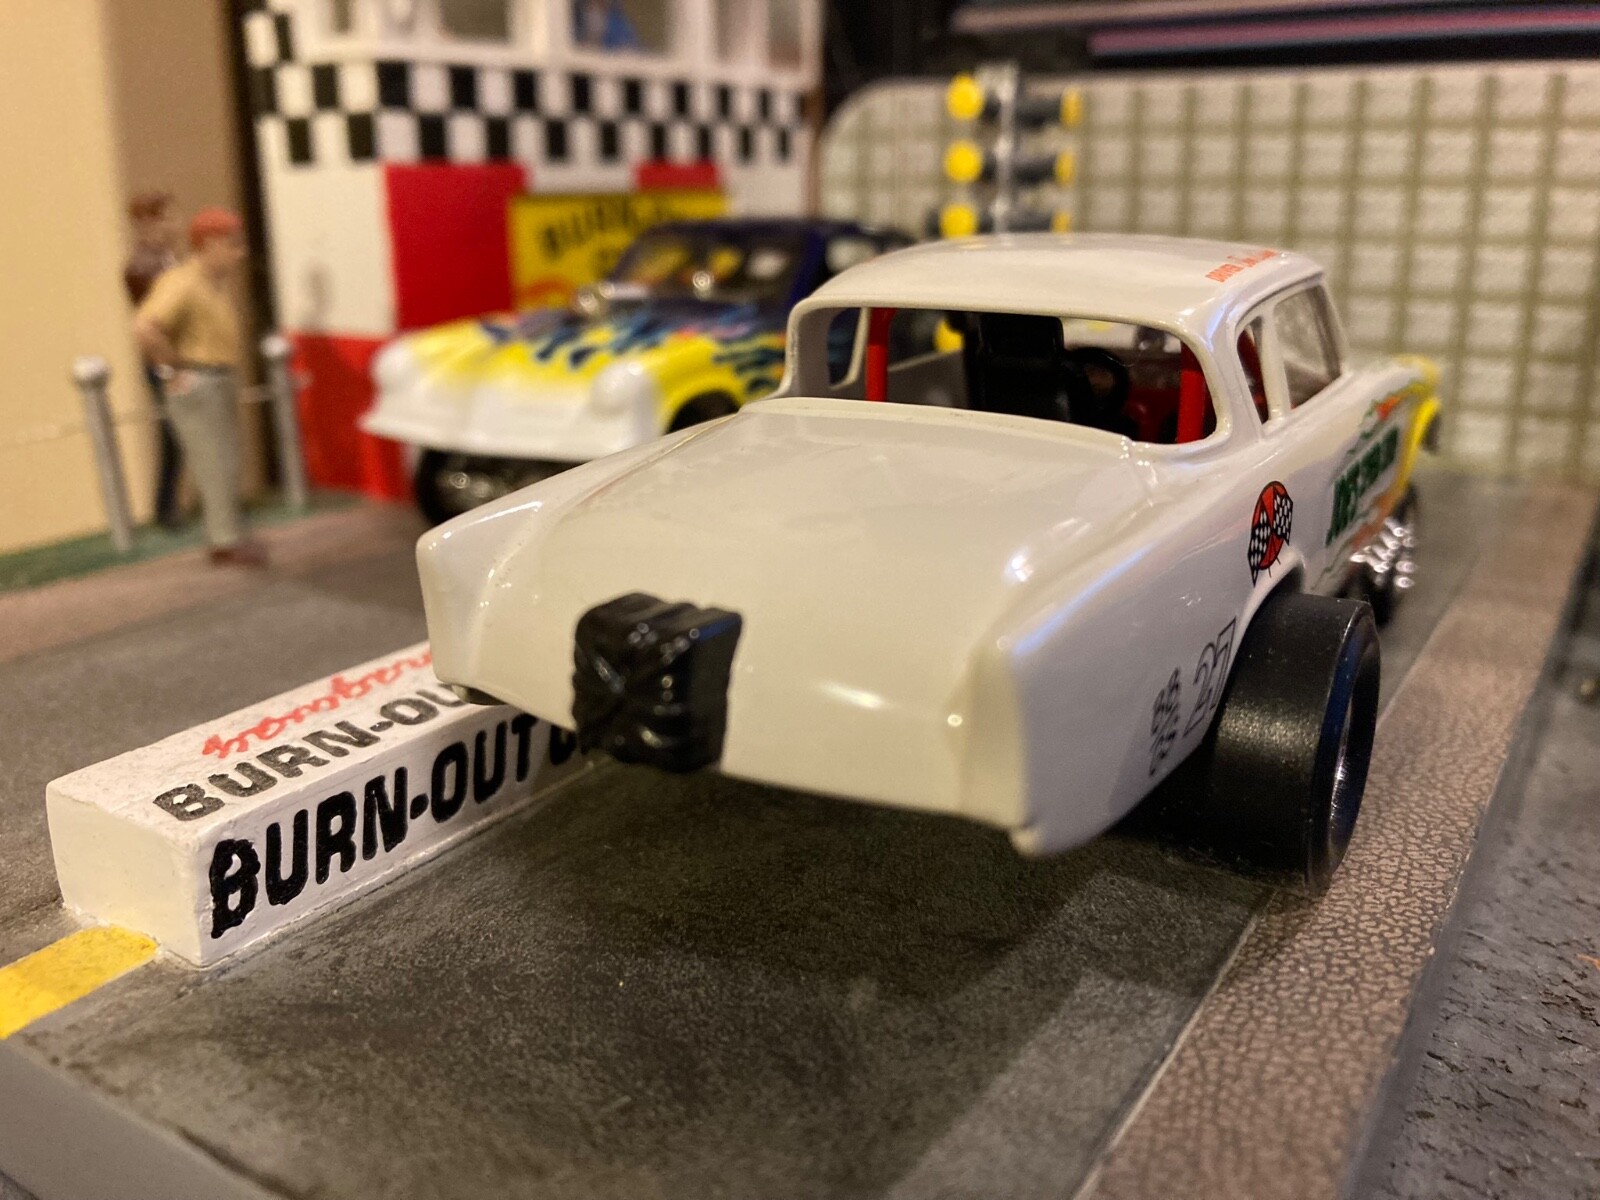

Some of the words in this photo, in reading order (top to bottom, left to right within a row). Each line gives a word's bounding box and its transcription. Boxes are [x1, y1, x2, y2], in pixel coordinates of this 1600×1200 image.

[1182, 615, 1237, 738] 27
[152, 683, 470, 822] BURN-OU
[209, 711, 538, 939] BURN-OUT
